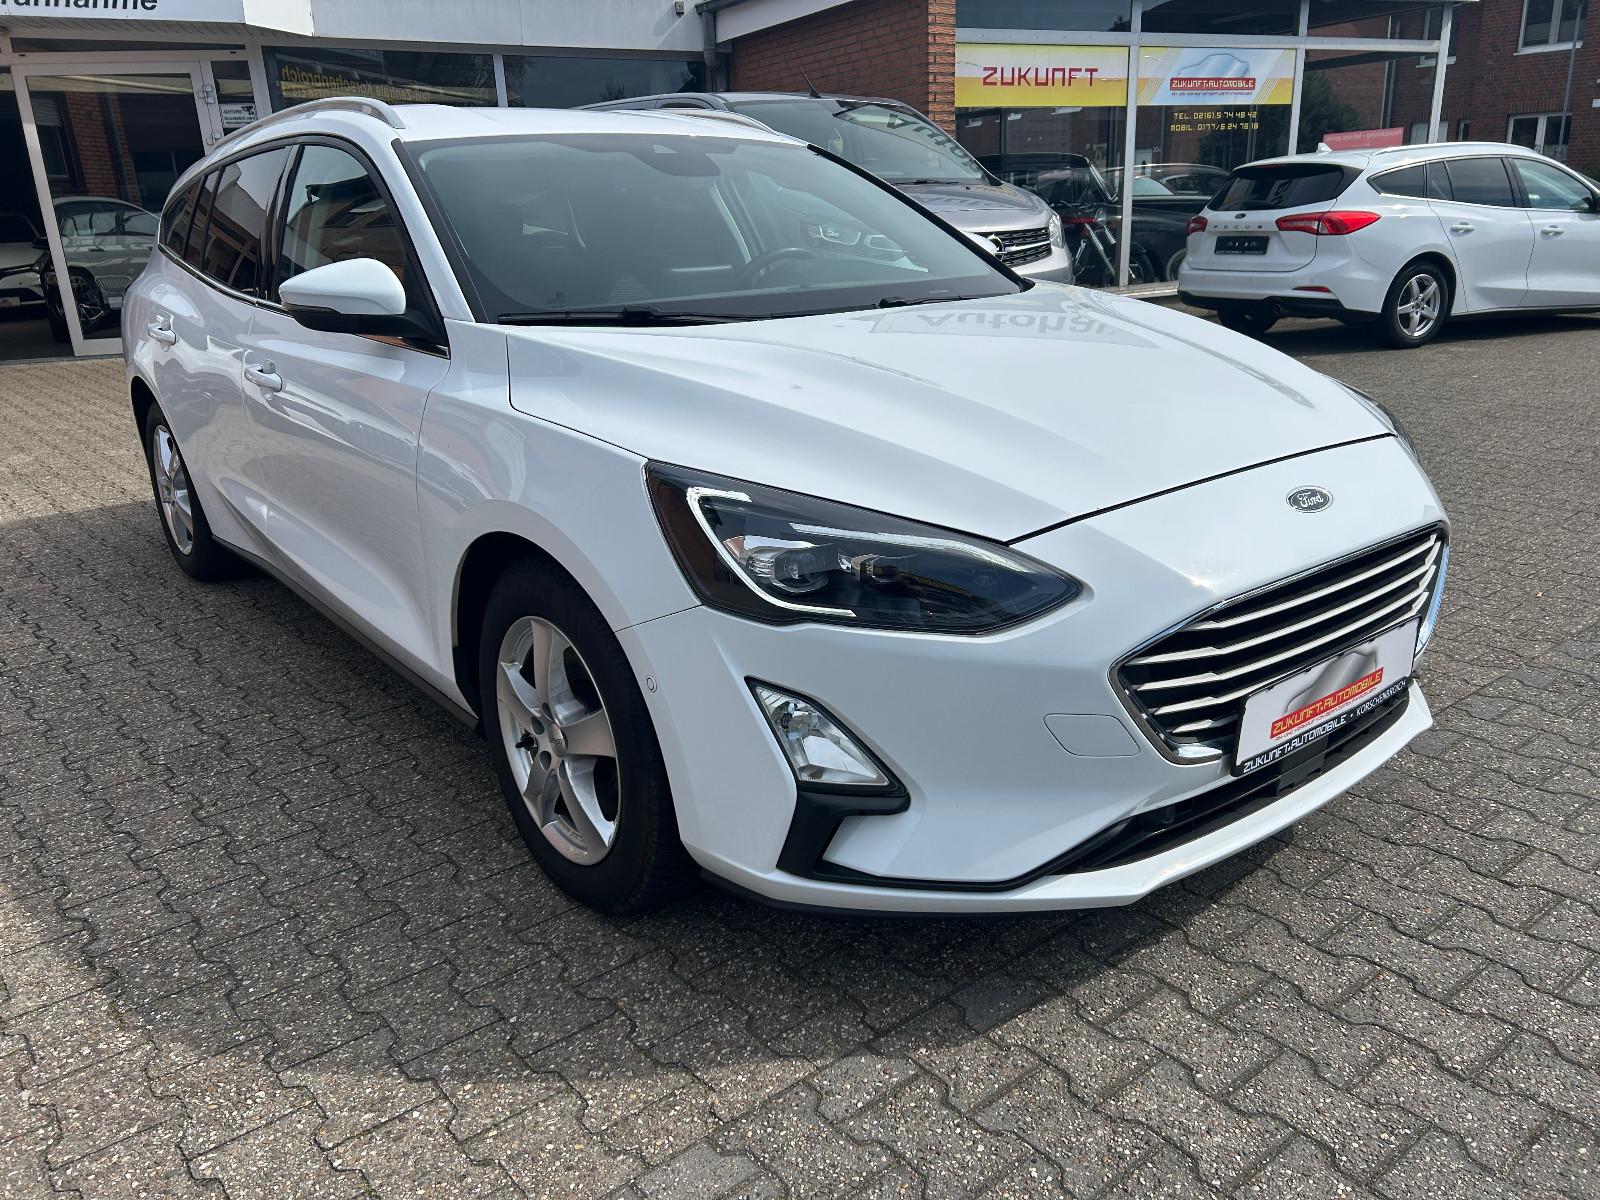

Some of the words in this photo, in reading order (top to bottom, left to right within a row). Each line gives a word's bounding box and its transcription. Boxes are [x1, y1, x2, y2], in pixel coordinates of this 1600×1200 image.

[982, 66, 1099, 87] ZUKUNFT
[1223, 111, 1234, 119] 74
[1297, 491, 1324, 508] Ford
